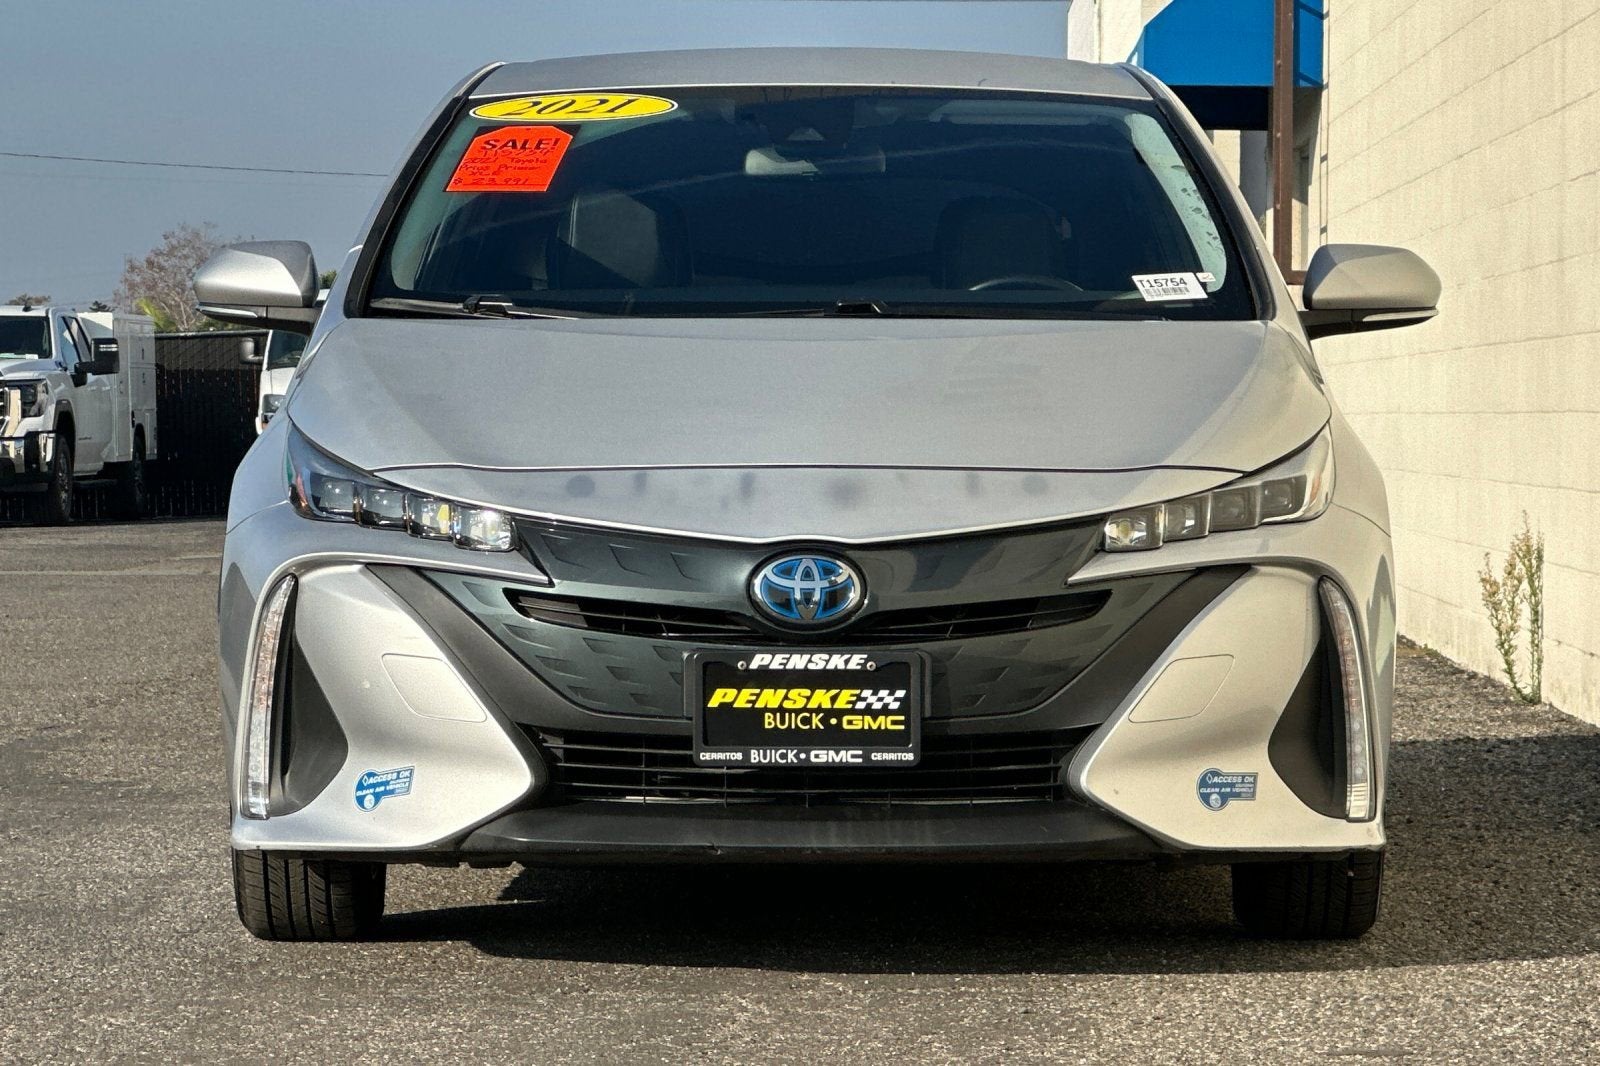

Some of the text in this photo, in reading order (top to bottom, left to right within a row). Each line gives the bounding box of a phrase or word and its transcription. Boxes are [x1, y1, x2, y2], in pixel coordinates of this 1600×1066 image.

[499, 98, 640, 116] 2021
[482, 138, 561, 150] SALE!
[1137, 277, 1187, 288] T15754
[749, 653, 868, 670] PENSKE
[707, 688, 862, 708] PENSKE
[764, 712, 905, 730] BUICK GMC
[699, 749, 914, 763] CERRITOS BUICK GMC CERRITOS
[368, 773, 397, 784] ACCESS
[399, 770, 411, 778] OK
[1212, 775, 1254, 783] ACCESS OK
[356, 788, 375, 796] CLEAN
